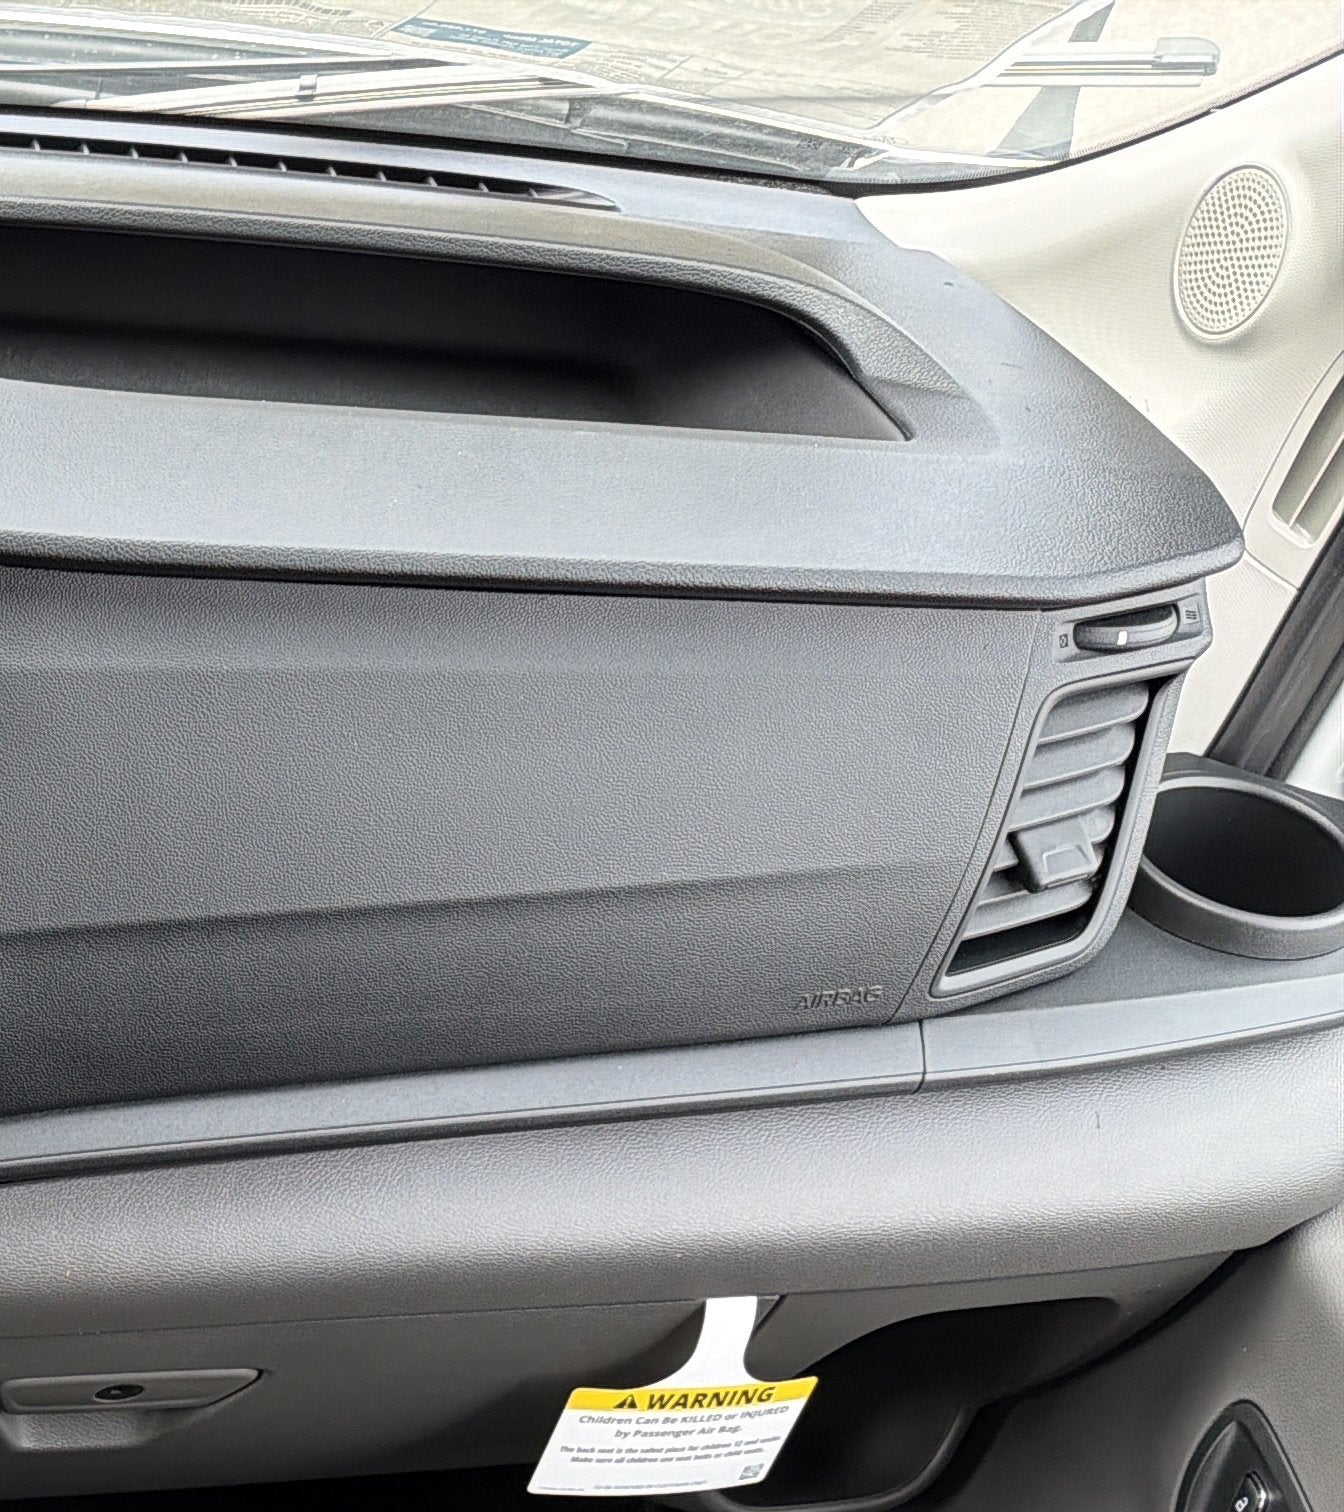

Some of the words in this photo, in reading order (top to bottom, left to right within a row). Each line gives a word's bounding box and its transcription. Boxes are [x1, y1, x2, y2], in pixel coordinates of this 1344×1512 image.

[795, 984, 883, 1010] AIRBAG
[646, 1386, 777, 1410] WARNING
[578, 1415, 633, 1424] Children
[635, 1416, 660, 1425] Can
[661, 1416, 678, 1425] Be
[680, 1413, 723, 1424] KILLED
[724, 1412, 739, 1421] or
[740, 1405, 790, 1419] INJURED
[614, 1429, 632, 1440] by
[633, 1428, 697, 1439] Passenger
[697, 1427, 716, 1435] Air
